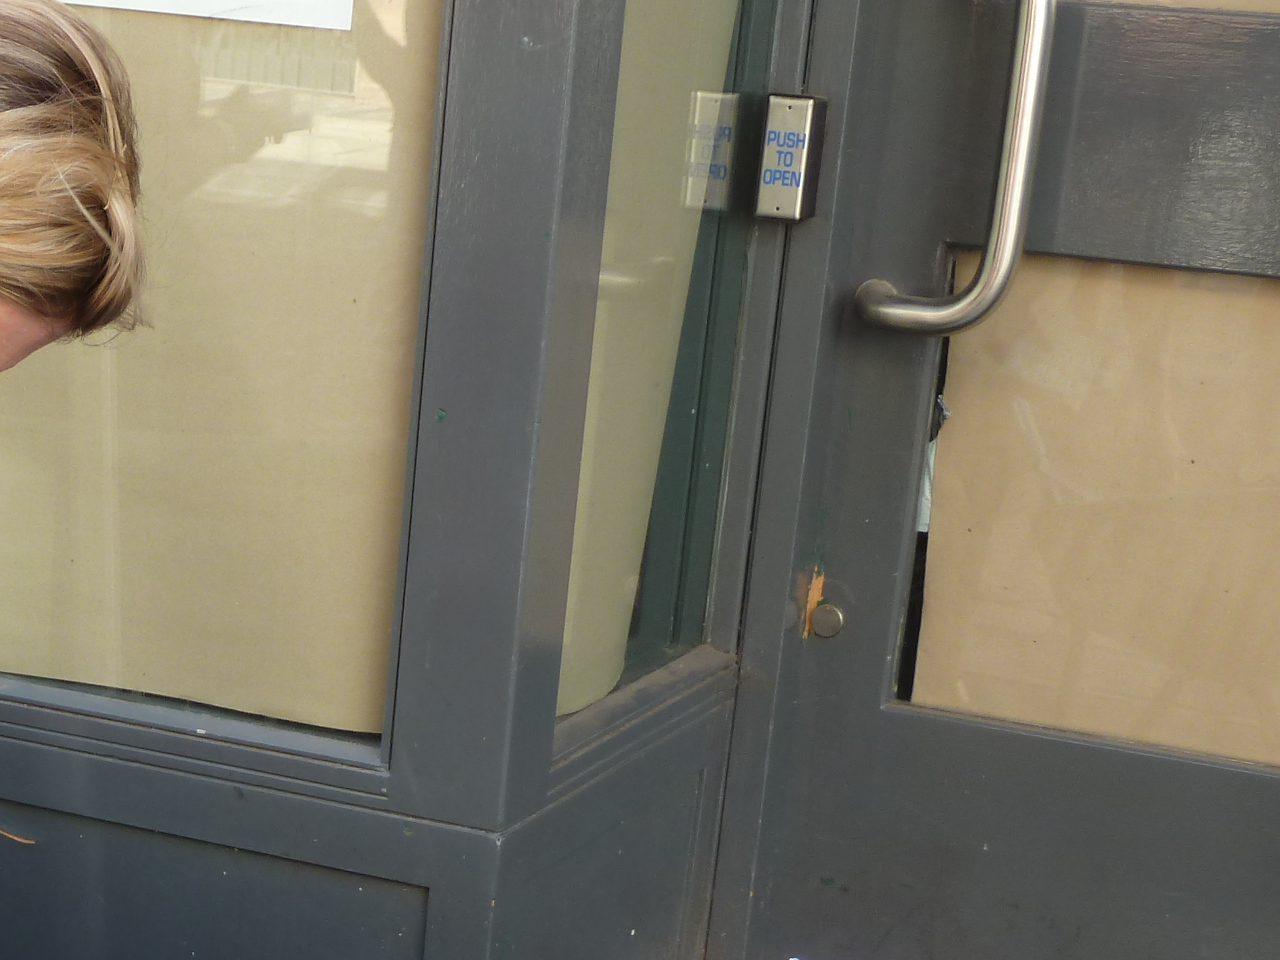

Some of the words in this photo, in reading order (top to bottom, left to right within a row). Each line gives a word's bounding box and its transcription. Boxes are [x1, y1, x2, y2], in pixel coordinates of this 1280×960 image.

[767, 131, 806, 149] PUSH
[776, 151, 794, 168] TO
[763, 169, 801, 187] OPEN
